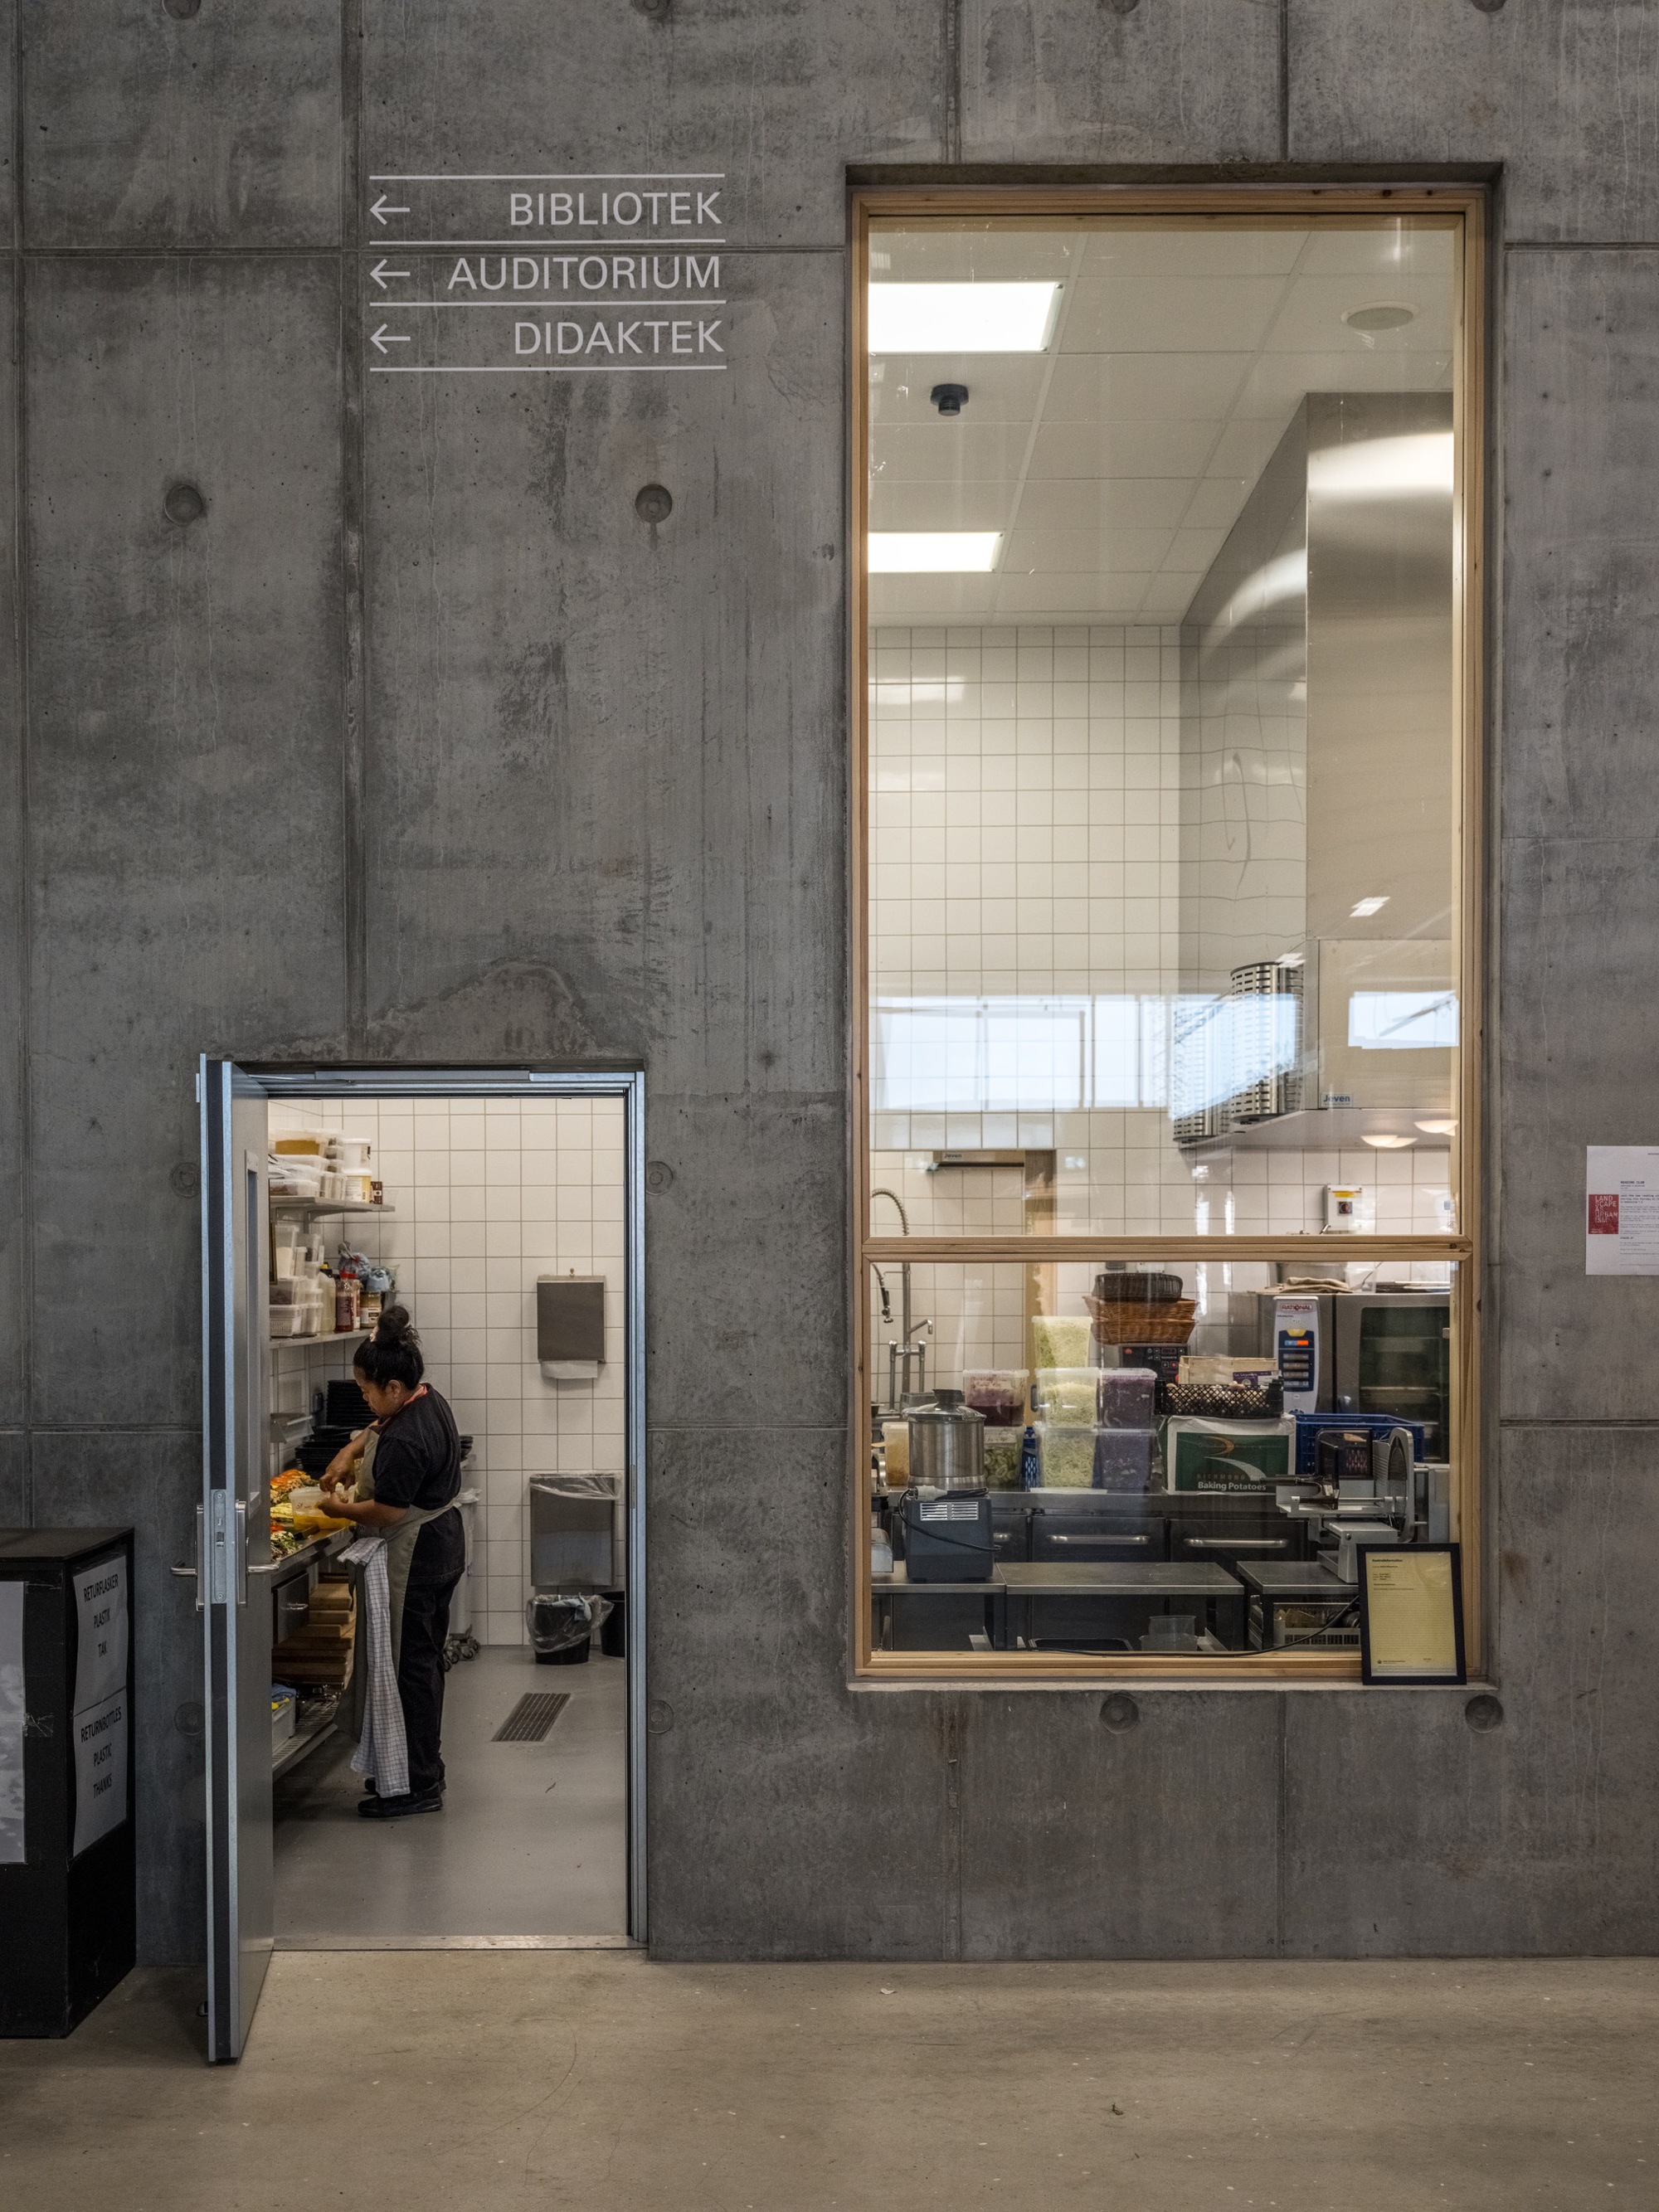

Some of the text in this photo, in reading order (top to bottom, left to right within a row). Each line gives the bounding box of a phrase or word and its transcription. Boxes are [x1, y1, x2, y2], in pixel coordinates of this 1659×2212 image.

[509, 192, 722, 226] BIBLIOTEK
[447, 255, 720, 290] AUDITORIUM
[514, 320, 724, 354] DIDAKTEK
[1198, 1481, 1267, 1491] Baking Potatoes
[84, 1573, 119, 1602] RETURFLASKER
[94, 1607, 111, 1630] PLASTIK
[98, 1641, 107, 1658] TAK
[80, 1706, 121, 1743] RETURNBOTTLES
[94, 1743, 112, 1767] PLASTIC
[93, 1772, 112, 1798] THANKS
